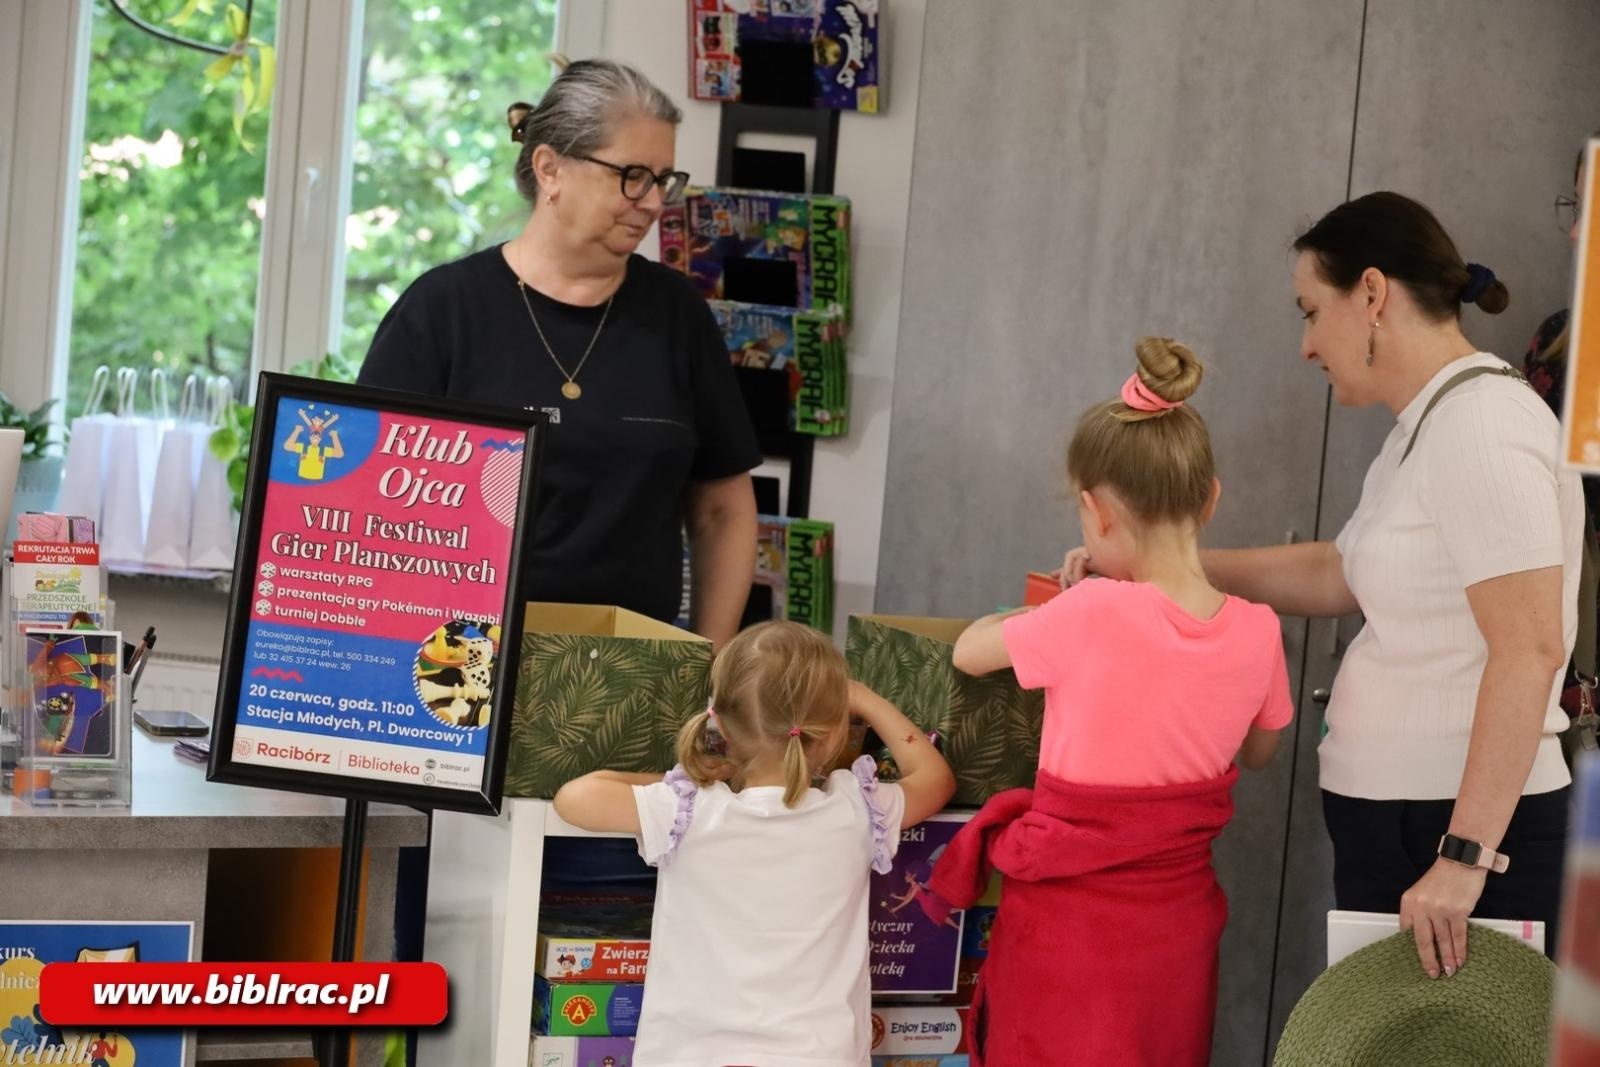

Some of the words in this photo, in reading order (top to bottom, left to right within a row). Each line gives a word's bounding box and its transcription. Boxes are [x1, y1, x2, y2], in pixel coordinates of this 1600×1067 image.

[379, 422, 474, 466] Klub
[379, 466, 466, 508] Ojca
[301, 504, 352, 533] VIII
[364, 514, 469, 549] Festiwal
[18, 545, 70, 554] REKRUTACJA
[71, 547, 96, 555] TRWA
[35, 555, 57, 563] CAŁY
[271, 532, 328, 561] Gier
[333, 541, 497, 585] Planszowych
[280, 567, 345, 587] warsztaty
[348, 575, 374, 588] RPG
[275, 604, 318, 622] turniej
[321, 610, 366, 627] Dobble
[277, 586, 355, 606] prezentacja
[358, 597, 380, 612] gry
[382, 599, 442, 618] Pokémon
[452, 609, 500, 625] Wazabi
[256, 629, 305, 643] Obowiązują
[306, 636, 335, 647] zapisy:
[253, 651, 267, 660] lub
[268, 653, 279, 662] 32
[295, 656, 306, 665] 37
[307, 658, 317, 667] 24
[318, 661, 340, 670] wew.
[362, 654, 379, 663] 334
[380, 656, 396, 666] 249
[249, 683, 268, 697] 20
[269, 689, 335, 709] czerwca,
[338, 696, 378, 713] godz.
[381, 701, 415, 716] 11:00
[246, 704, 293, 723] Stacja
[297, 710, 364, 732] Młodych,
[368, 720, 384, 733] Pl.
[388, 723, 465, 747] Dworcowy
[466, 733, 473, 745] 1
[257, 742, 331, 764] Racibórz
[348, 754, 420, 776] Biblioteka
[890, 1022, 919, 1034] Enjoy
[921, 1022, 956, 1034] English
